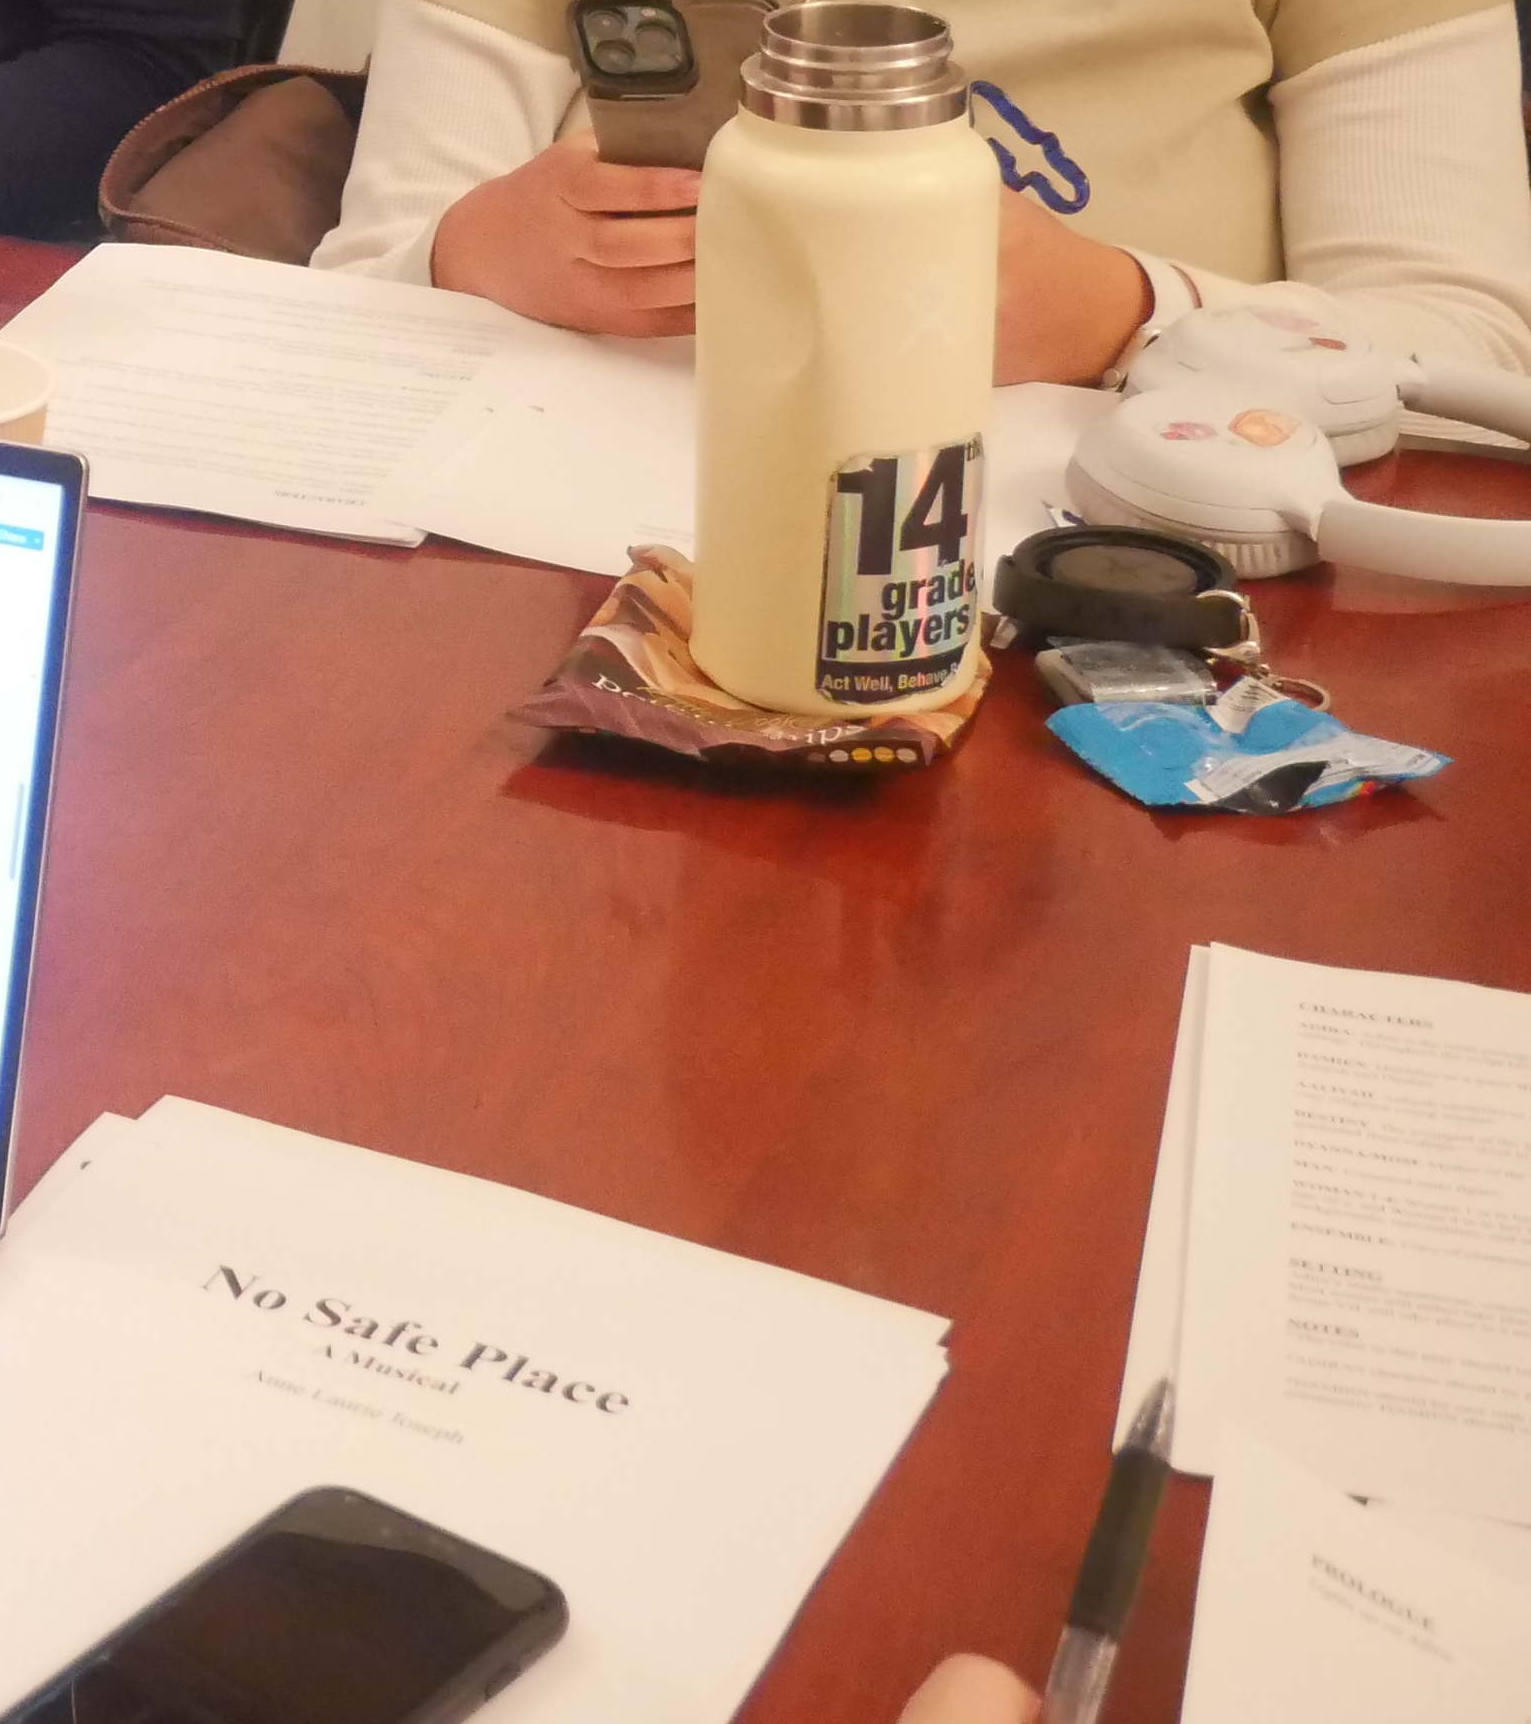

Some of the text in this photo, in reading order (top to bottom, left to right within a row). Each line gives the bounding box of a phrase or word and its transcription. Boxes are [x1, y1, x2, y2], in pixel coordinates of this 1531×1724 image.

[881, 557, 977, 621] grade
[825, 602, 970, 660] players
[821, 673, 850, 691] Act
[854, 675, 894, 693] Well,
[1299, 999, 1433, 1031] CHARACTERS
[1288, 1257, 1383, 1282] SETTING
[201, 1263, 633, 1415] No Safe Place
[1287, 1318, 1359, 1338] NOTES
[312, 1342, 463, 1397] A Musical
[246, 1367, 308, 1397] Anne
[391, 1411, 466, 1446] Joseph
[1310, 1553, 1437, 1633] PROLOGUE
